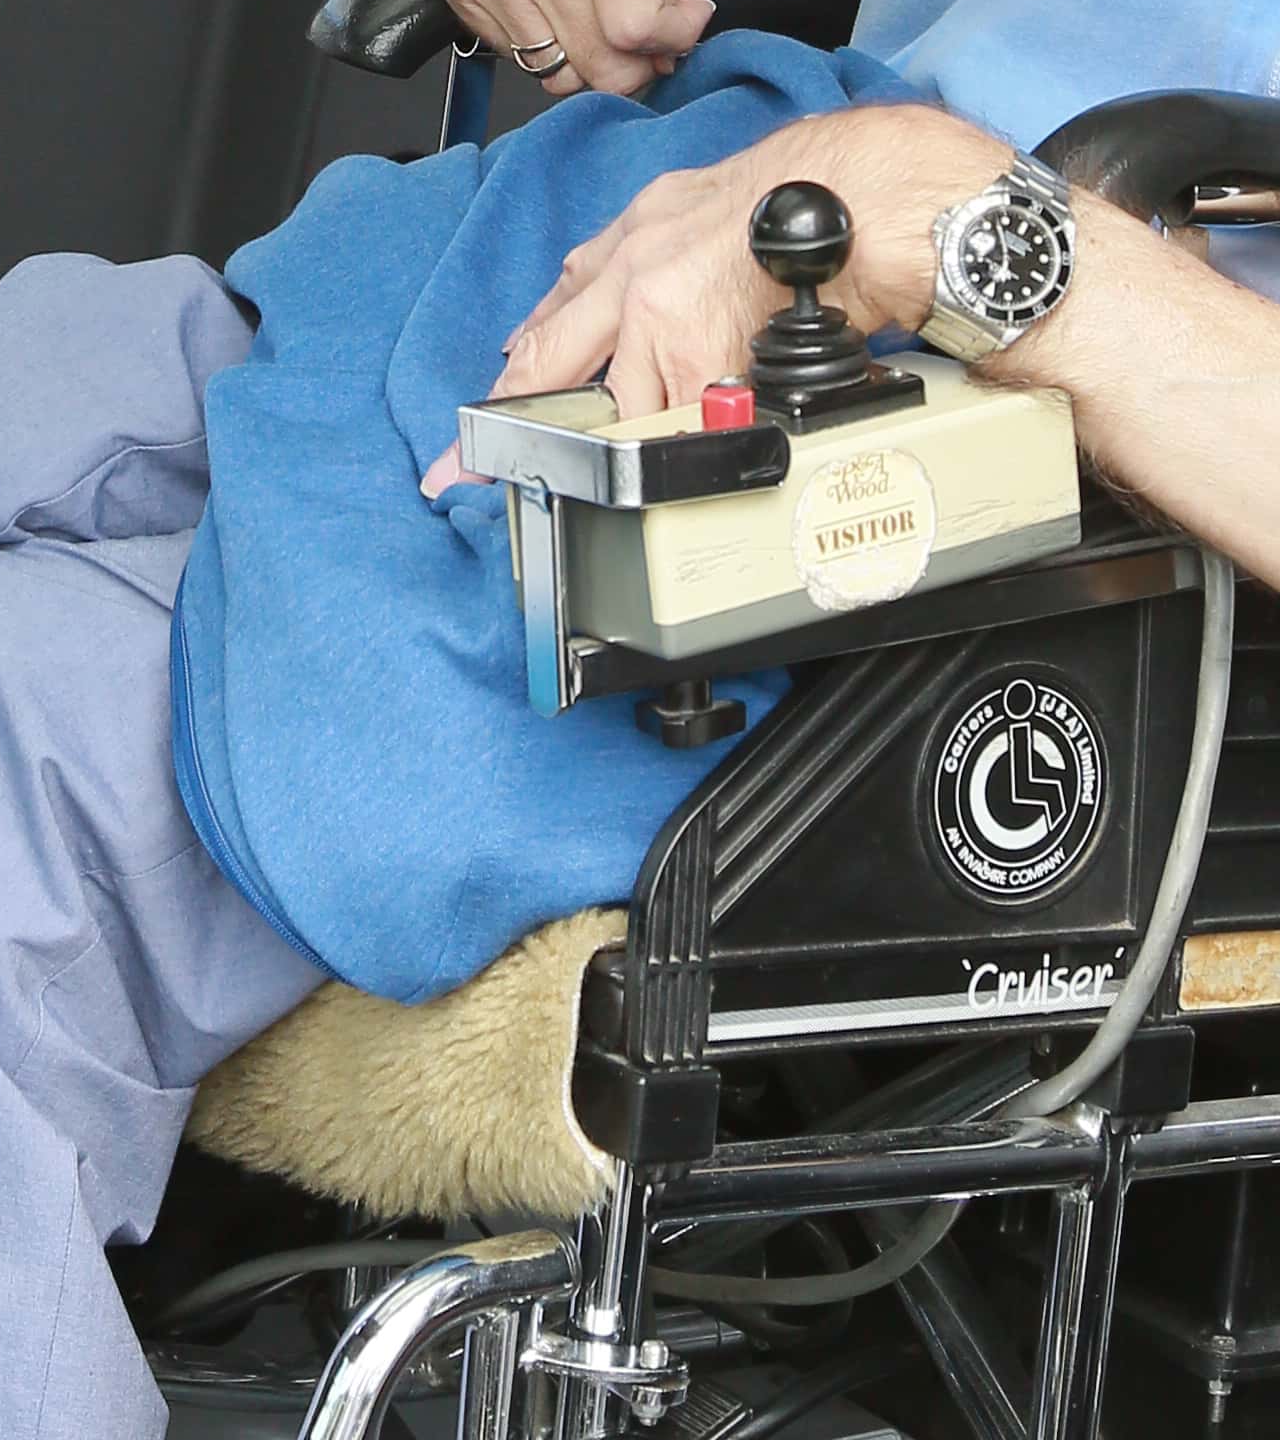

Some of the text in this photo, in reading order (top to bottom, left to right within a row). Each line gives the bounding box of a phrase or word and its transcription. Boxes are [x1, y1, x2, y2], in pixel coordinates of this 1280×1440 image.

[827, 472, 890, 505] Wood
[816, 510, 917, 555] VISITOR
[944, 704, 994, 774] Carters
[1076, 737, 1097, 806] Limited
[945, 826, 962, 850] AN
[1008, 847, 1067, 886] COMPANY
